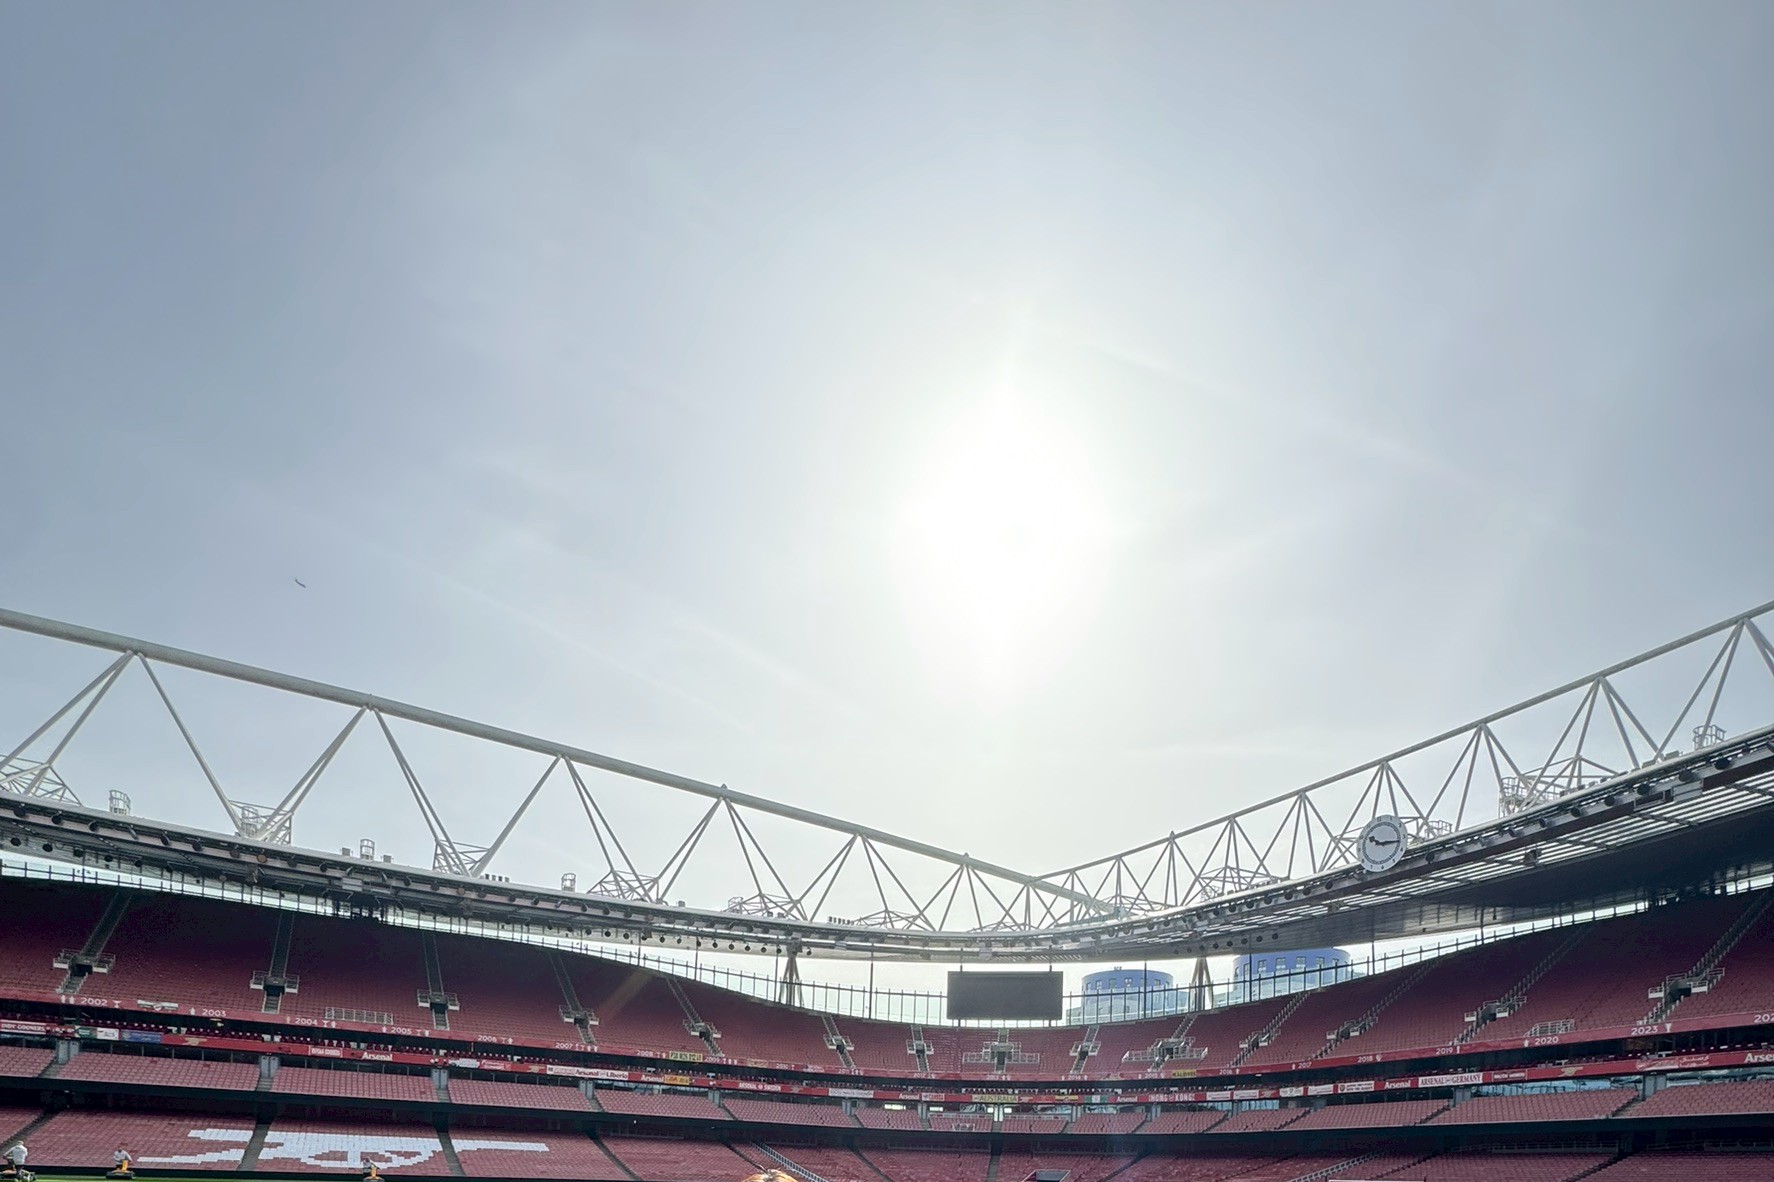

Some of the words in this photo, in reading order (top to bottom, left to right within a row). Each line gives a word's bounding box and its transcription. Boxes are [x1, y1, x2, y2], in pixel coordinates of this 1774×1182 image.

[80, 997, 108, 1007] 2002
[202, 1008, 227, 1018] 2003
[295, 1017, 318, 1026] 2004
[391, 1026, 412, 1035] 2005
[1631, 1025, 1658, 1036] 2023
[1535, 1035, 1559, 1046] 2020
[555, 1042, 574, 1050] 2007
[362, 1051, 394, 1062] Arsenal
[1435, 1047, 1454, 1056] 2019
[640, 1074, 665, 1085] Arsenal
[1384, 1079, 1411, 1090] Arsenal
[1420, 1075, 1445, 1087] ARSENAL
[1451, 1072, 1482, 1085] GERMANY
[898, 1093, 920, 1101] Arsenal
[1115, 1096, 1139, 1104] Arsenal
